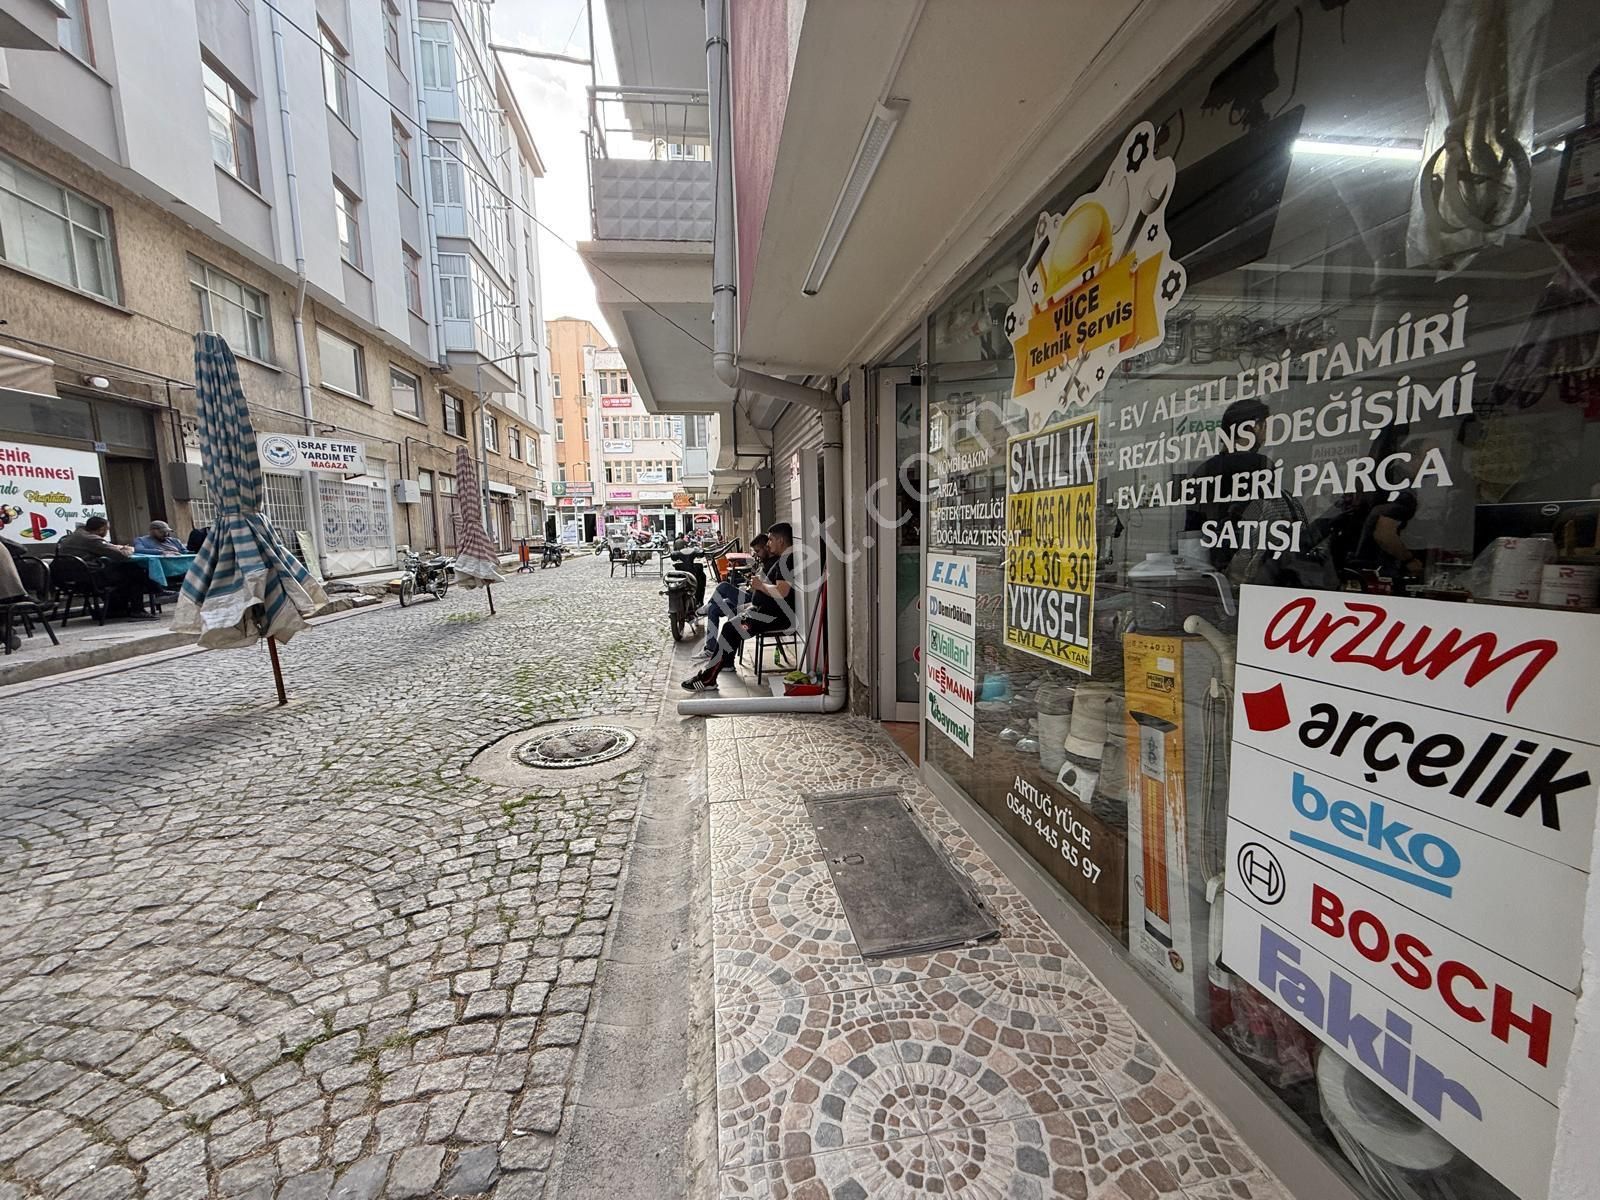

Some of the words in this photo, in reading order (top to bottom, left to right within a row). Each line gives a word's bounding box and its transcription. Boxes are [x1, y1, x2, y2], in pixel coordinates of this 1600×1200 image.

[1030, 331, 1071, 367] Teknik
[1076, 300, 1132, 344] Servis
[1054, 284, 1099, 332] YÜCE
[1120, 401, 1149, 431] EV
[1152, 348, 1292, 423] ALETLERİ
[1301, 294, 1469, 385] TAMİRİ
[1118, 420, 1257, 472] REZİSTANS
[1263, 360, 1477, 448] DEĞİŞİMİ
[297, 440, 327, 451] İSRAF
[331, 444, 357, 454] ETME
[301, 451, 341, 462] YARDIM
[311, 461, 348, 470] MAĞAZA
[937, 457, 961, 476] KOMBİ
[962, 447, 989, 469] BAKIM
[1010, 422, 1094, 493] SATILIK
[937, 483, 958, 498] ARIZA
[1117, 484, 1146, 510] EV
[1149, 458, 1283, 508] ALETLERİ
[1292, 447, 1453, 502] PARÇA
[937, 505, 960, 521] PETEK
[960, 497, 1004, 520] TEMİZLİĞİ
[1036, 495, 1054, 549] 665
[1058, 494, 1071, 549] 01
[1076, 492, 1091, 550] 66
[936, 525, 979, 546] DOĞALGAZ
[980, 526, 1022, 548] TESİSAT
[1200, 518, 1302, 560] SATIŞI
[1009, 549, 1036, 584] 813
[1042, 550, 1061, 588] 30
[1067, 552, 1090, 592] 30
[938, 600, 972, 626] DemirDöküm
[1008, 584, 1089, 648] YÜKSEL
[937, 631, 970, 668] Vaillant
[1264, 596, 1558, 714] arzum
[928, 664, 973, 705] VIESSMANN
[935, 704, 969, 747] baymak
[1298, 701, 1592, 832] arçelik
[1006, 792, 1032, 826] 0545
[1034, 818, 1058, 849] 445
[1061, 839, 1079, 867] 85
[1082, 857, 1101, 884] 97
[1013, 775, 1052, 818] ARTUĞ
[1054, 805, 1091, 851] YÜCE
[1291, 771, 1462, 880] beko
[1310, 883, 1553, 1068] BOSCH
[1257, 923, 1483, 1122] Fakir
